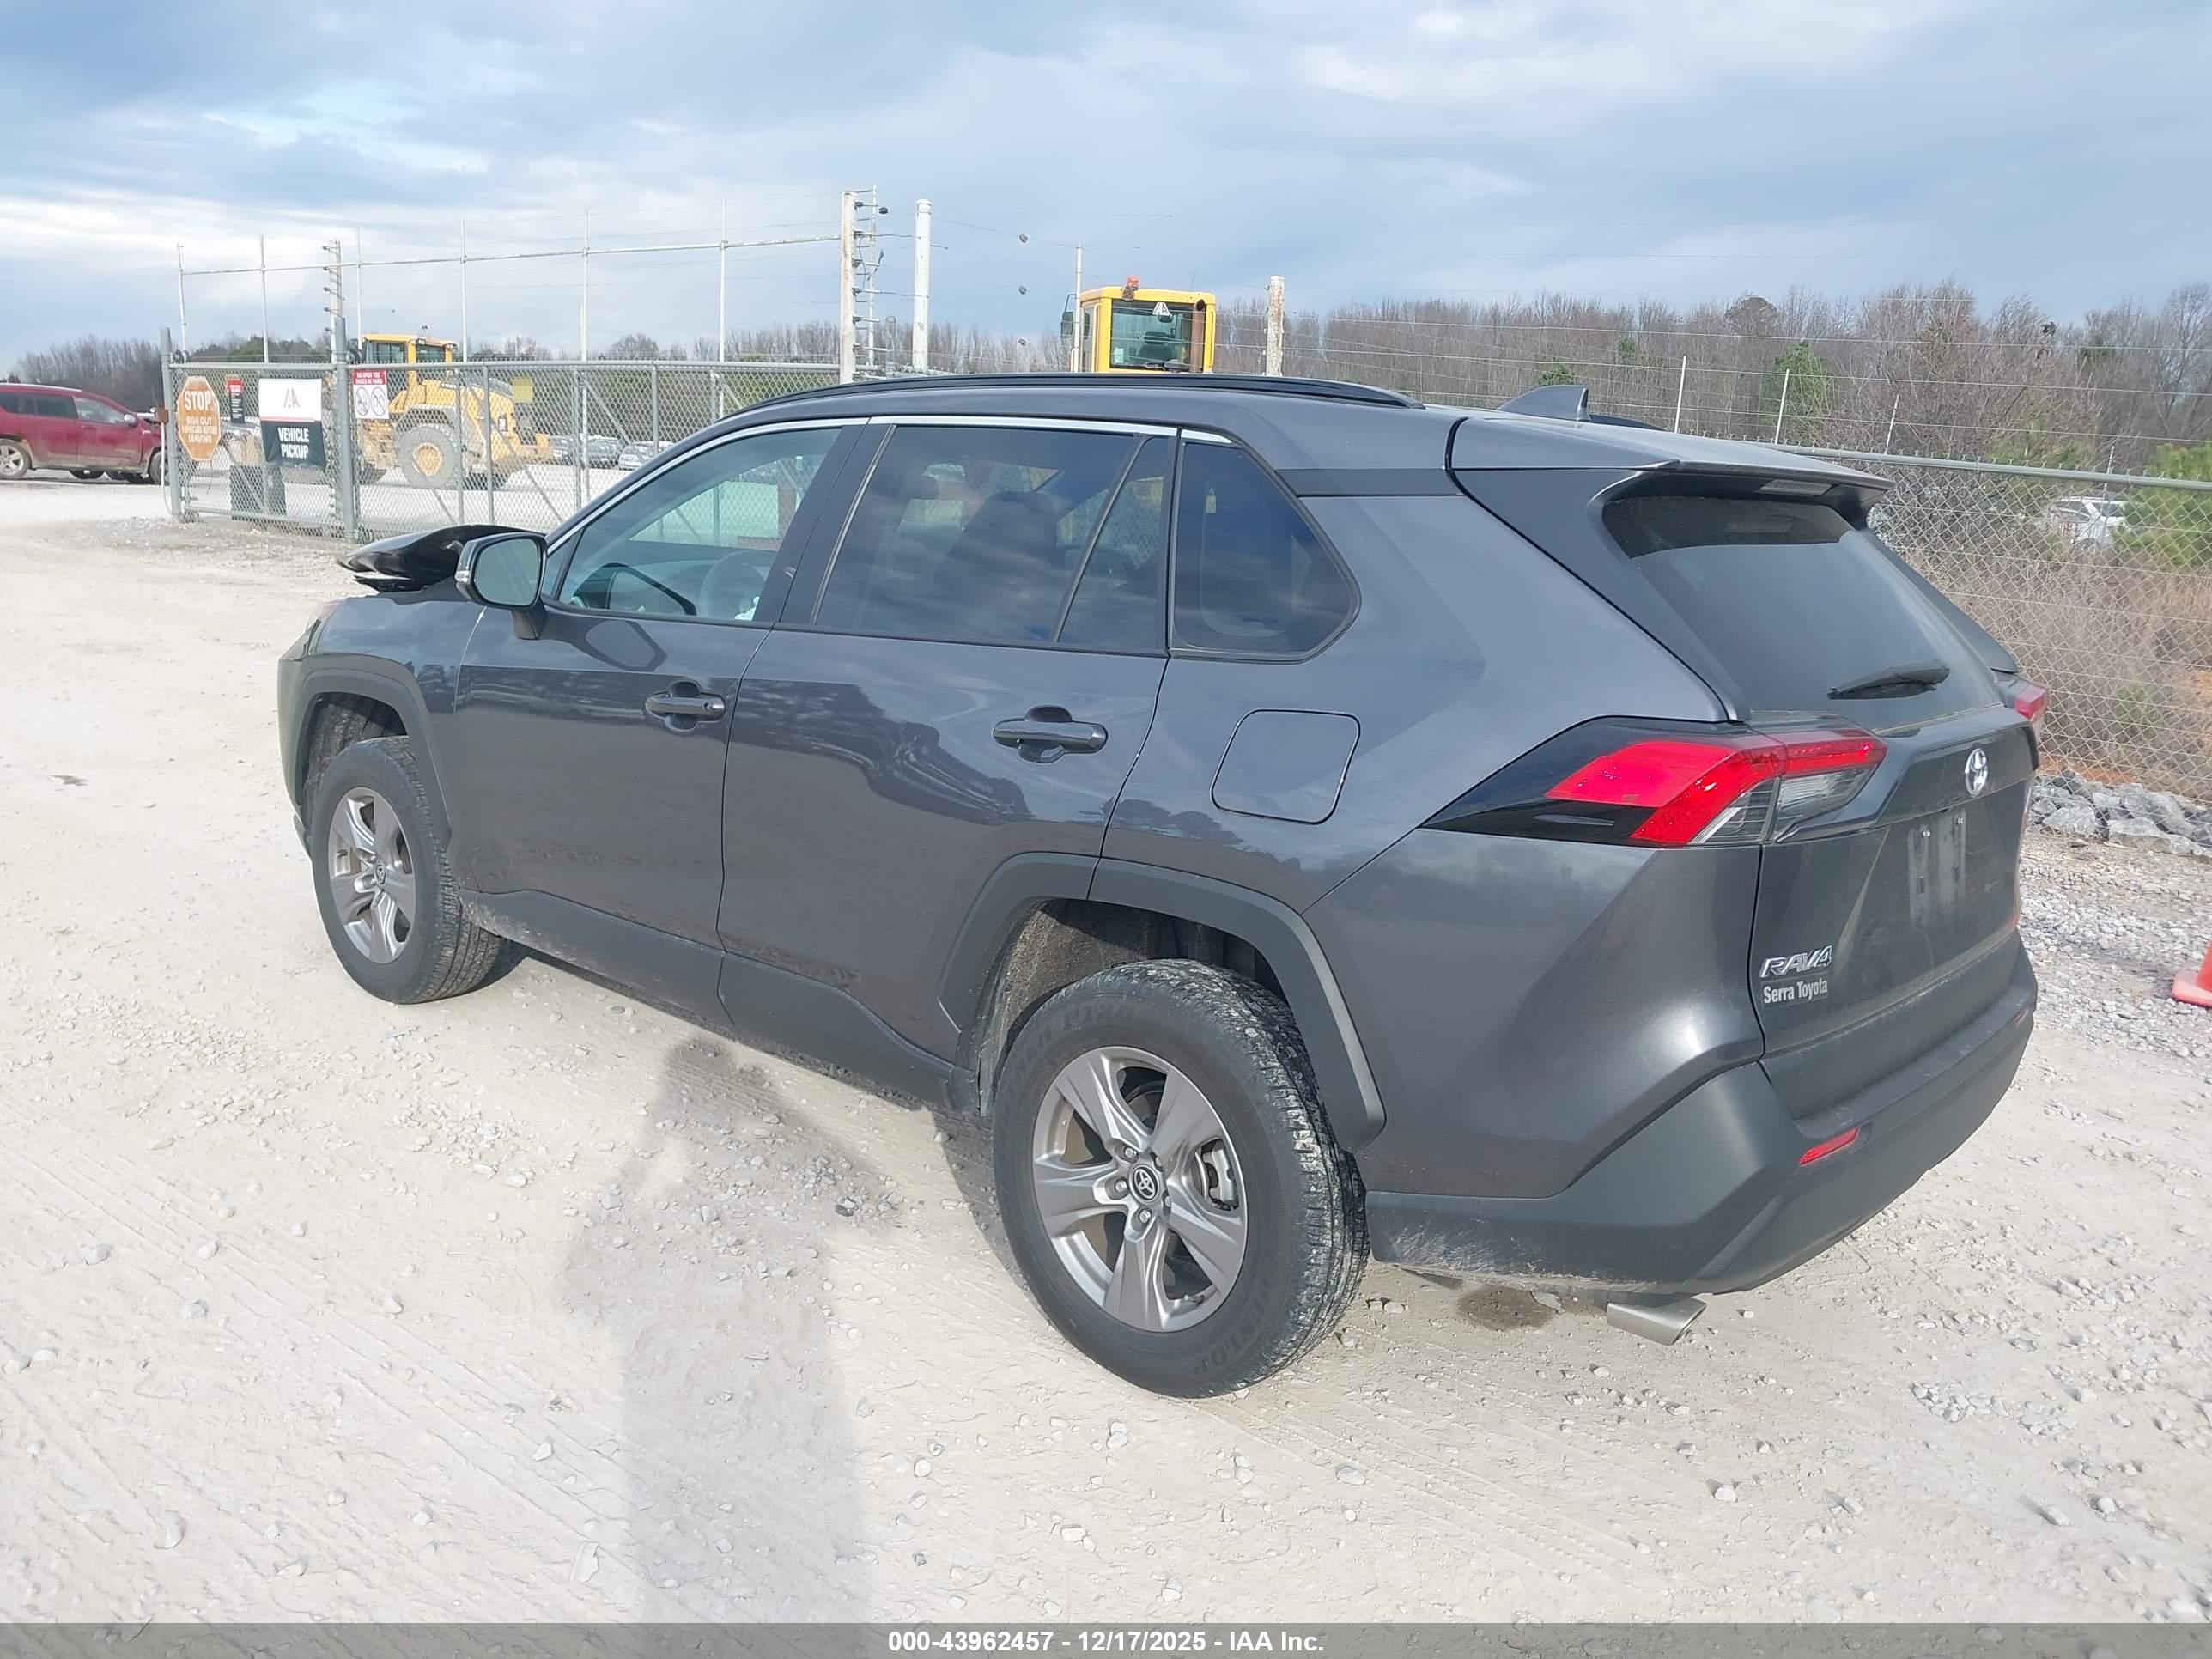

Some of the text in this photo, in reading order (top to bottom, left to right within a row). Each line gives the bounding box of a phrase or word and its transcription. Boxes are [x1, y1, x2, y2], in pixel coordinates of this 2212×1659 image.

[184, 390, 211, 411] STOP
[199, 416, 212, 426] OUT
[188, 434, 212, 444] LEAVING
[277, 428, 310, 442] VEHICLE
[280, 443, 309, 459] PICKUP
[1759, 945, 1832, 978] RAV4
[1763, 978, 1828, 1004] Serra Toyota
